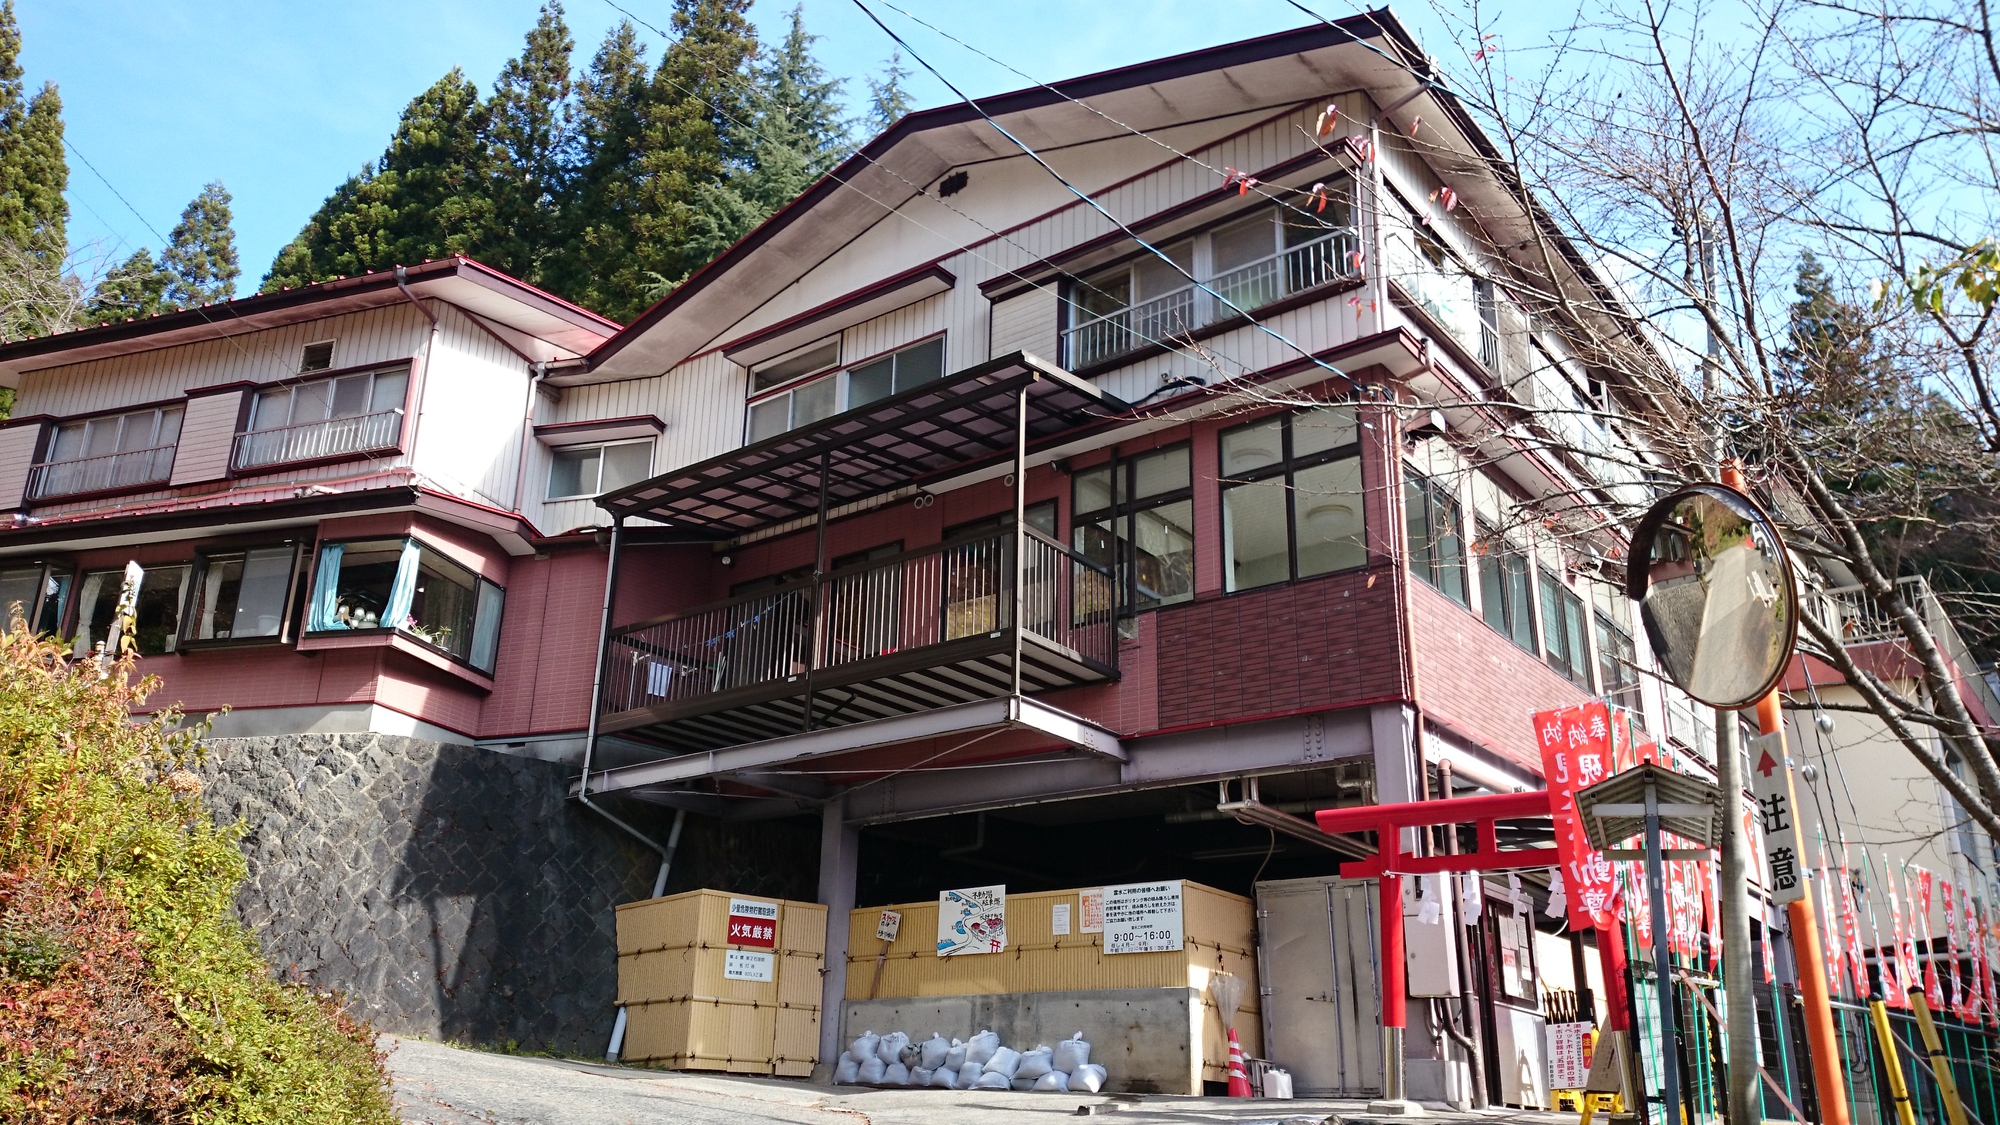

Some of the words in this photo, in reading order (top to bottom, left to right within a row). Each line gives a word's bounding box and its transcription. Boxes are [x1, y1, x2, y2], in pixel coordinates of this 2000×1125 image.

[1758, 793, 1797, 892] 注意
[730, 923, 773, 940] 火気厳禁
